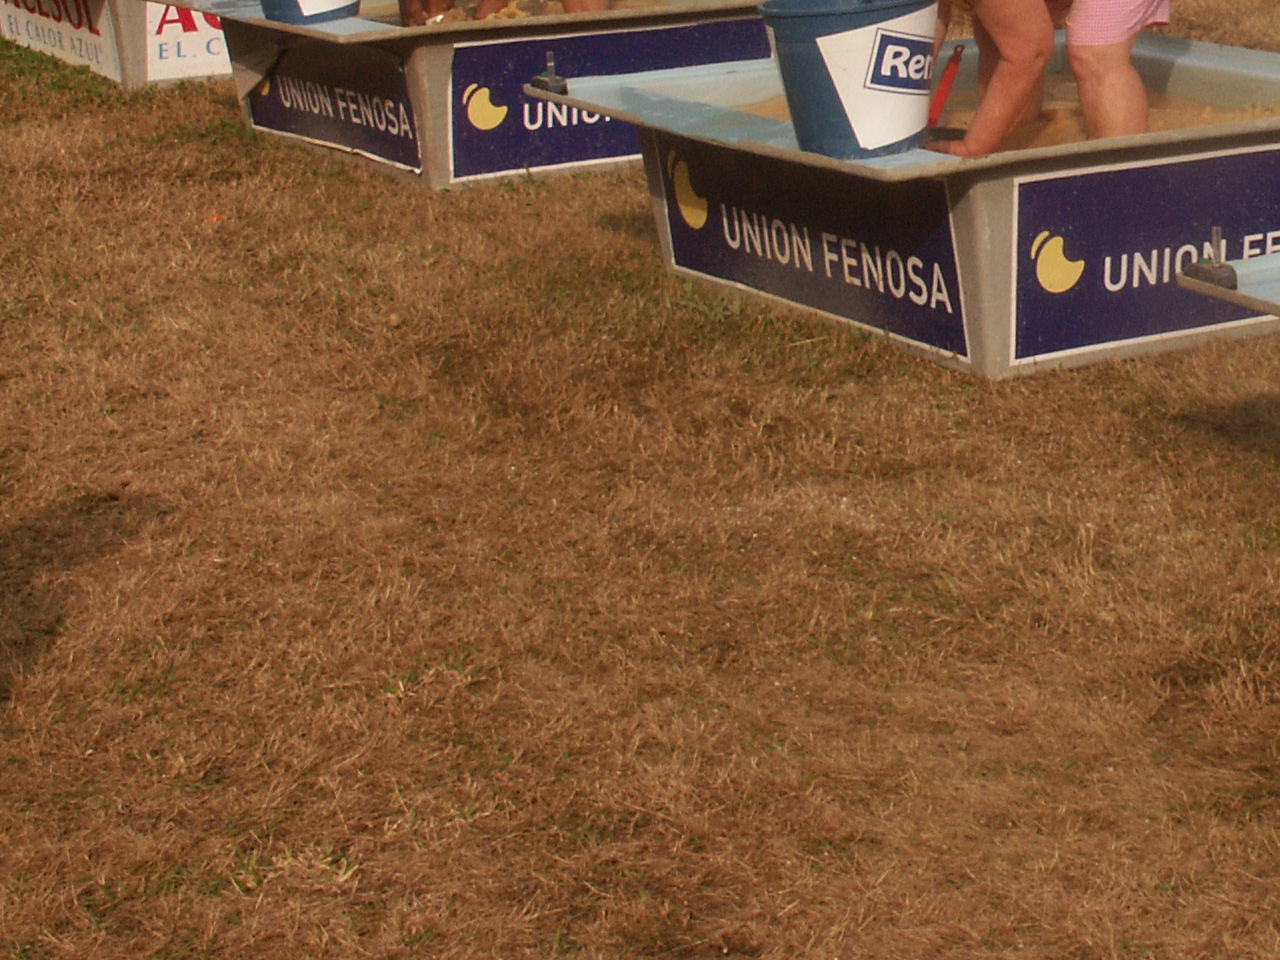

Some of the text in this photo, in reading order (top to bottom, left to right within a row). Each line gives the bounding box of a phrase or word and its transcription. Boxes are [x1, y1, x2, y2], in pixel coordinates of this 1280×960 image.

[7, 14, 101, 64] EL CALOR AZUL
[276, 74, 414, 140] UNION FENOSA
[523, 101, 612, 131] UNIO
[721, 203, 953, 314] UNION FENOSA
